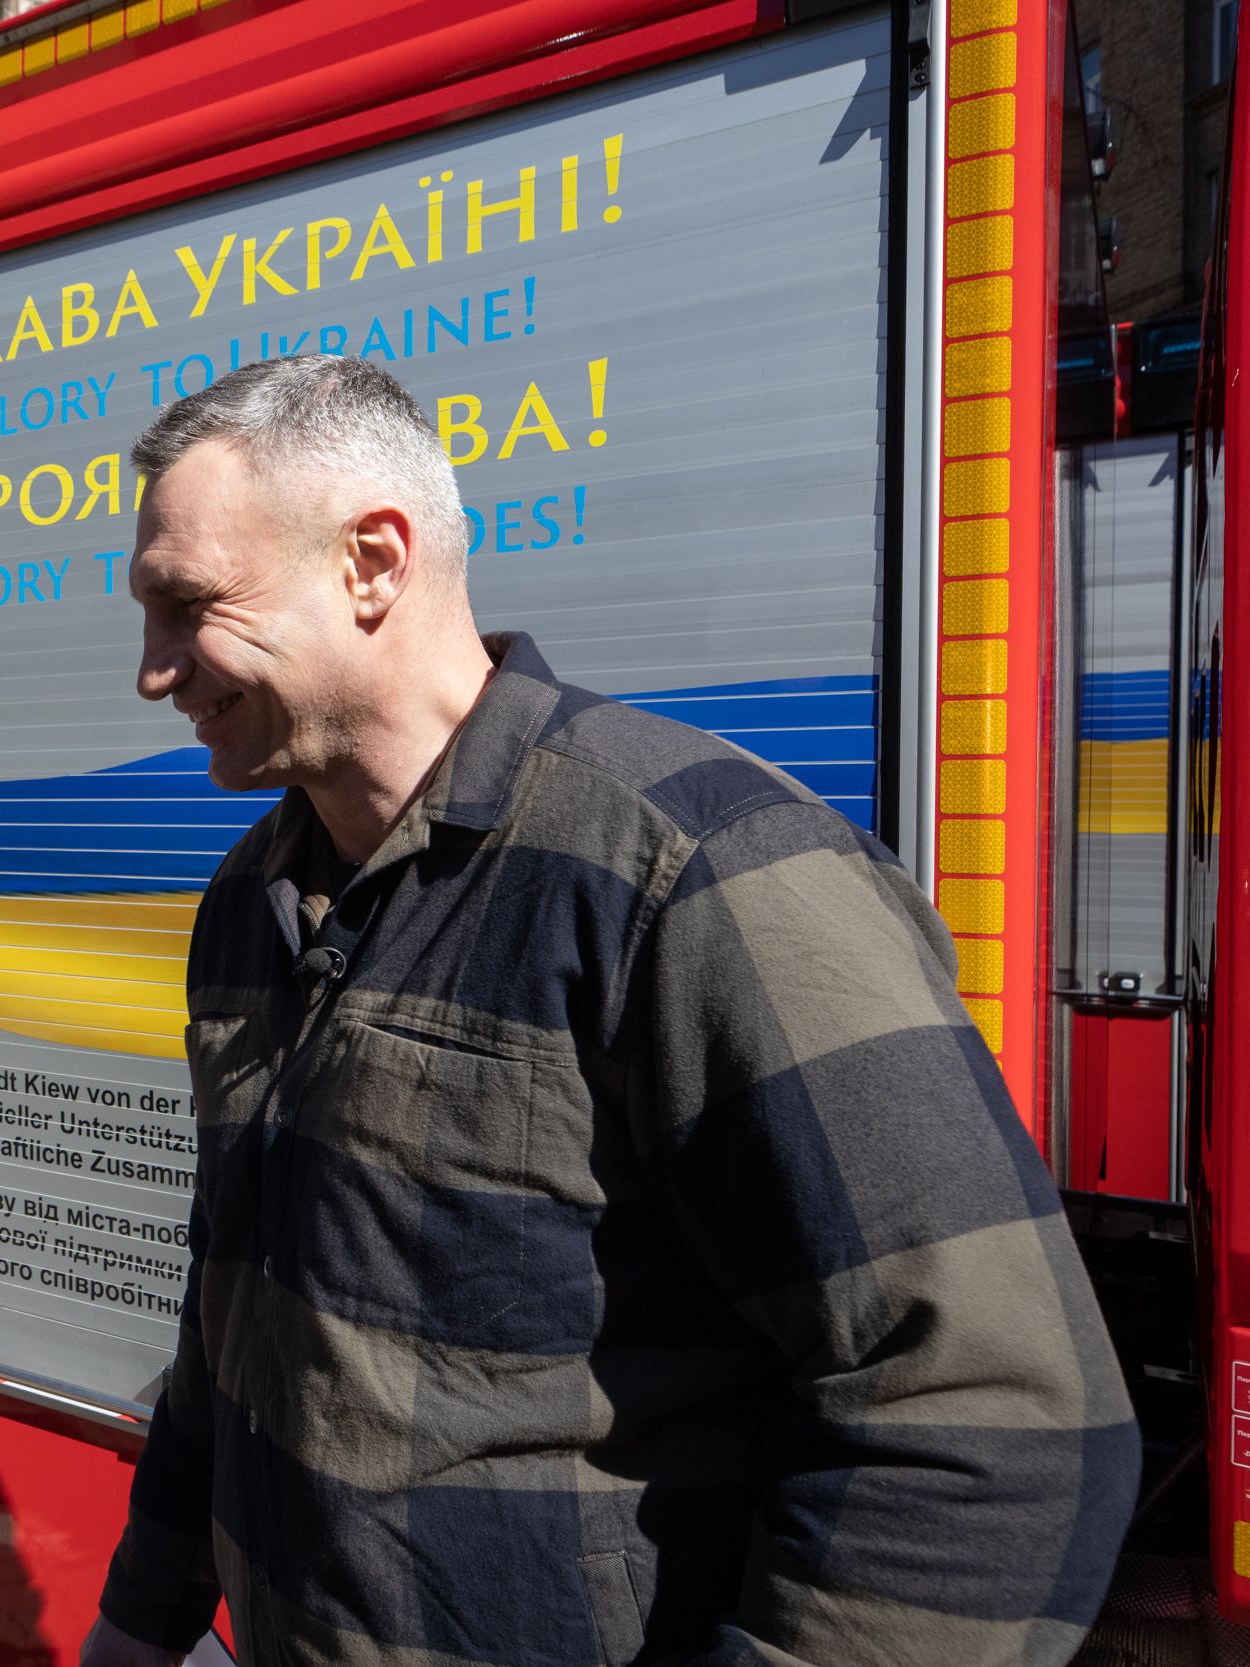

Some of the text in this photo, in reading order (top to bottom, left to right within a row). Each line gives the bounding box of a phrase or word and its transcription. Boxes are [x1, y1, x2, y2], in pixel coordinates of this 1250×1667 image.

[175, 133, 625, 318] УКРАЇНІ!
[141, 354, 214, 408] TO
[94, 551, 131, 595] T
[24, 1073, 79, 1101] Kiew
[86, 1087, 130, 1108] von
[140, 1090, 181, 1115] der
[60, 1111, 198, 1154] Unterstützu
[91, 1149, 196, 1189] Zusamm
[24, 1197, 59, 1226] від
[67, 1206, 188, 1248] міста-поб
[54, 1236, 182, 1282] підтримки
